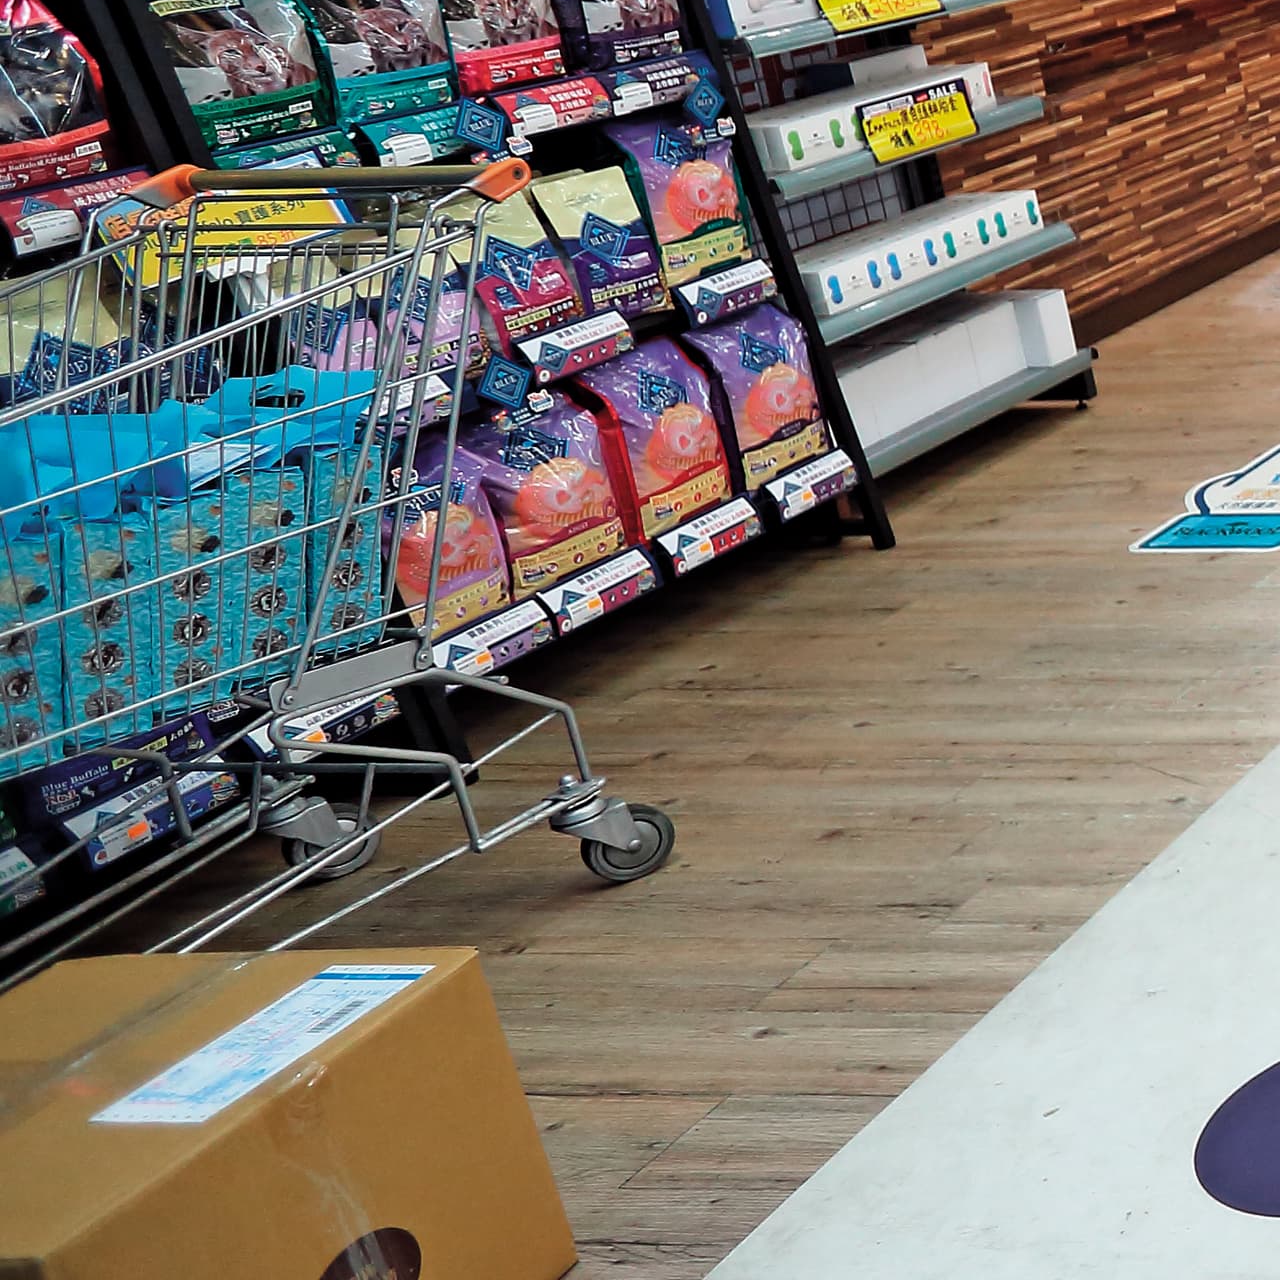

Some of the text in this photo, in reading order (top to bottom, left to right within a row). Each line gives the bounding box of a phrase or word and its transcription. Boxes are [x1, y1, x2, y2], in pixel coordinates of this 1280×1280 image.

[928, 83, 959, 100] SALE
[493, 375, 519, 390] BLUE
[41, 764, 110, 794] Blue Buffalo
